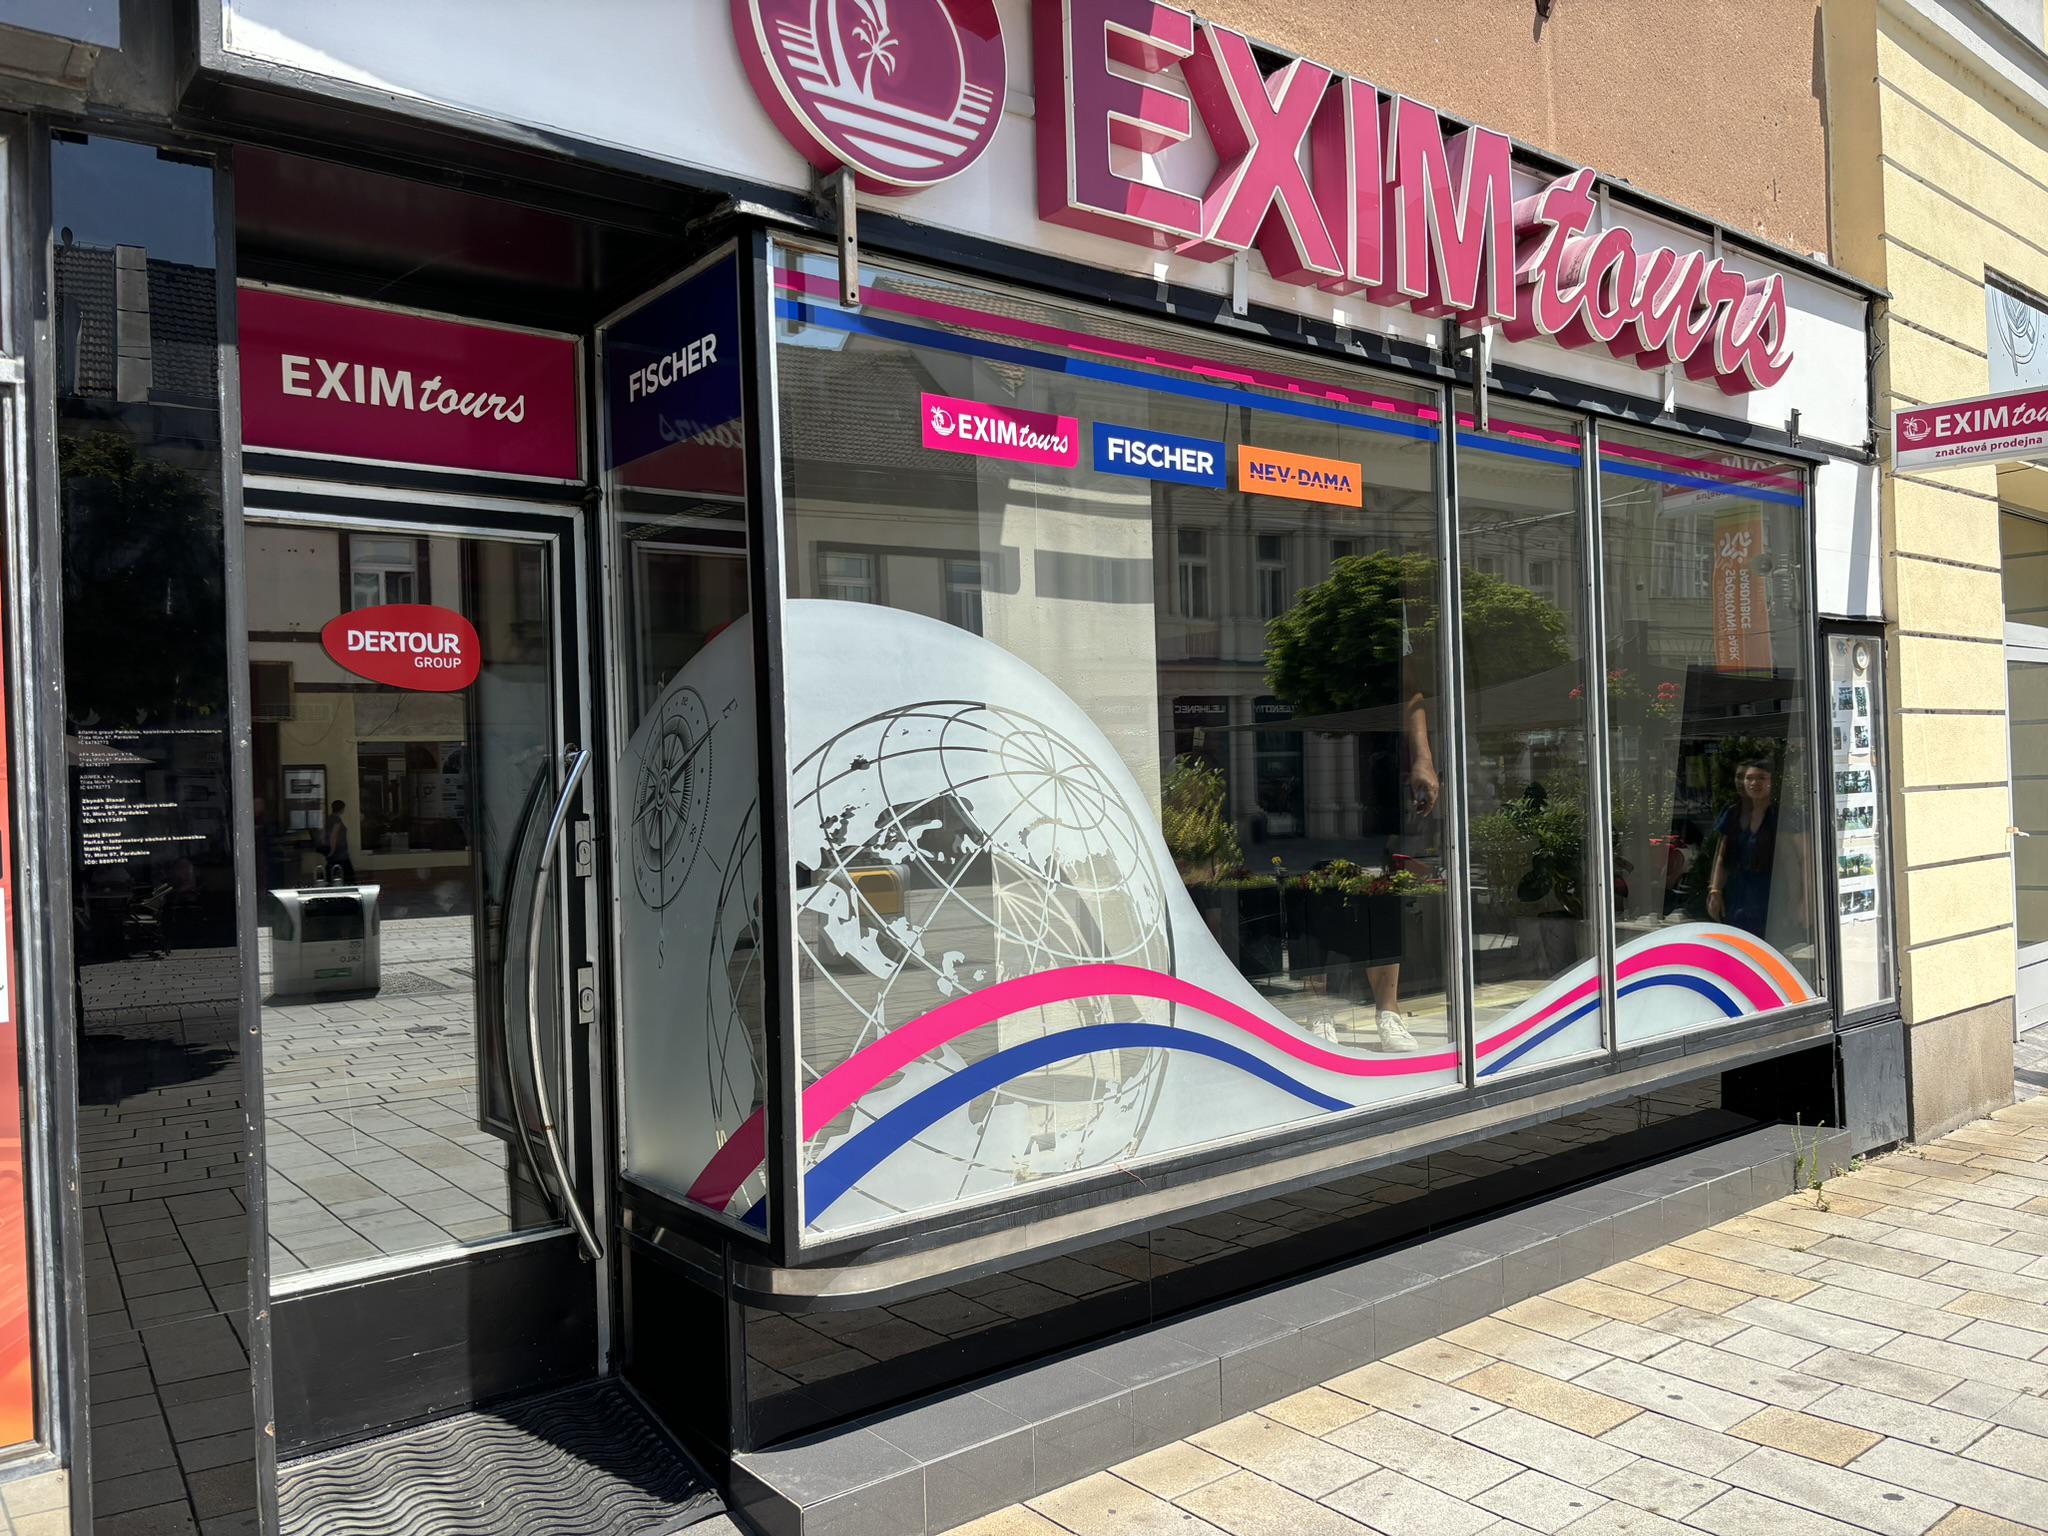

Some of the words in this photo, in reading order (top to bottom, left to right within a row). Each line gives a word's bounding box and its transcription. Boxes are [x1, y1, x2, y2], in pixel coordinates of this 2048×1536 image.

[628, 333, 718, 403] FISCHER
[1107, 437, 1215, 476] FISCHER
[1935, 441, 1988, 458] značková
[1990, 436, 2043, 452] prodejna
[1248, 461, 1353, 494] NEV-DAMA
[347, 629, 462, 655] DERTOUR
[413, 655, 462, 669] GROUP
